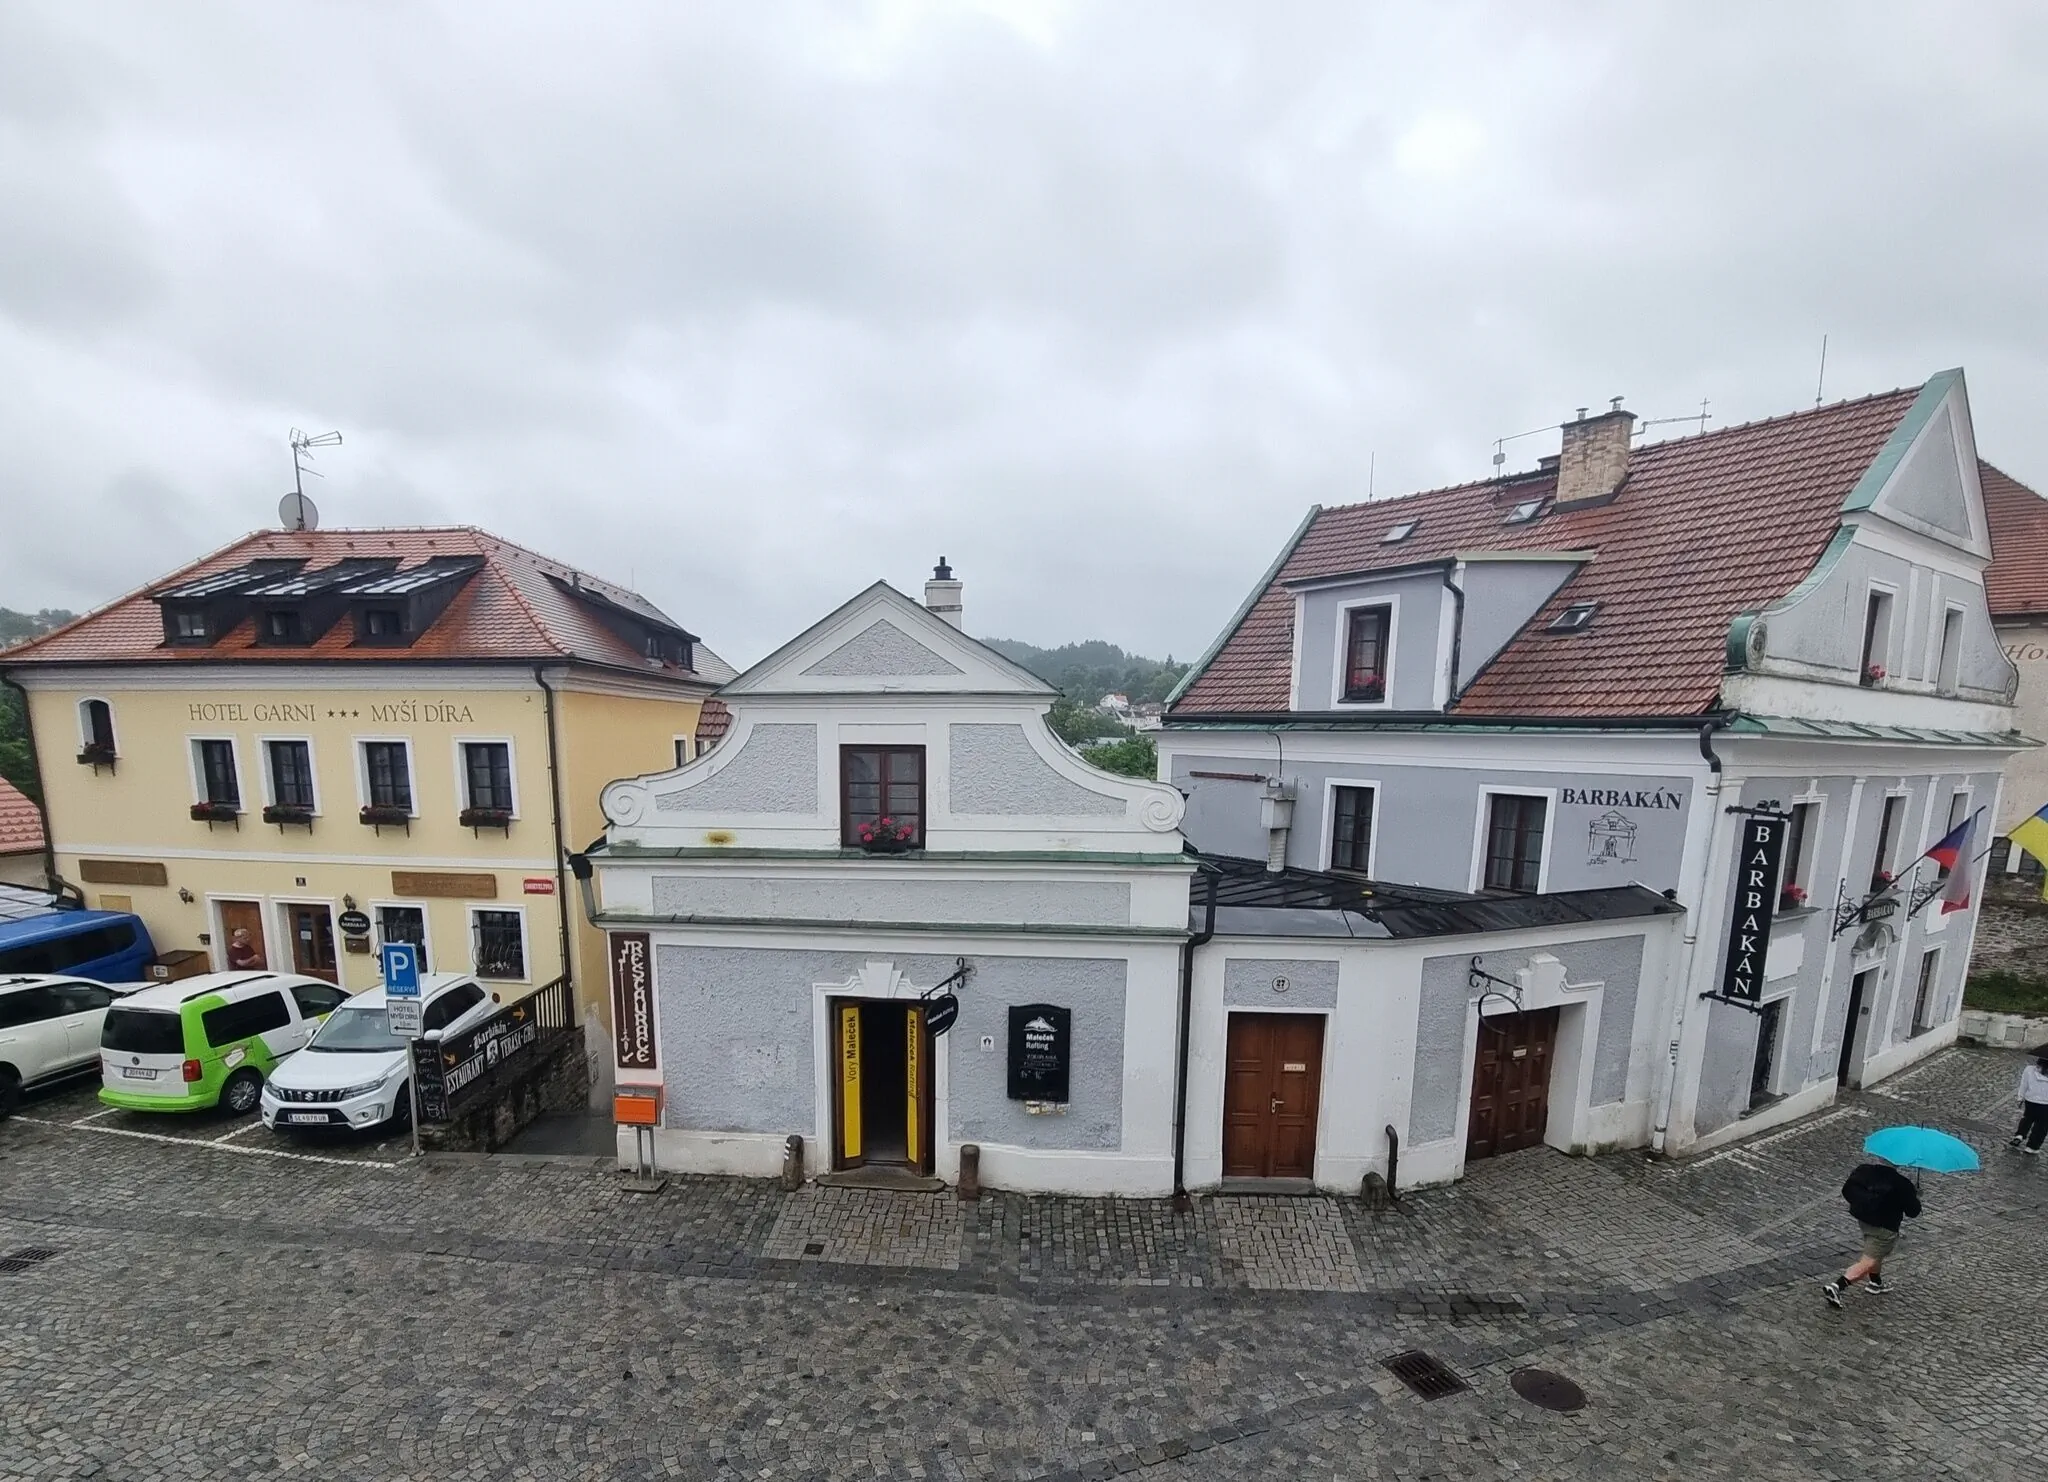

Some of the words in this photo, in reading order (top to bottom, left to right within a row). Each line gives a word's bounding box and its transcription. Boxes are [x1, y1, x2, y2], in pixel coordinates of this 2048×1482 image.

[2002, 642, 2048, 660] Ho
[188, 703, 249, 721] HOTEL
[253, 703, 316, 722] GARNI
[371, 699, 418, 722] MYŠÍ
[424, 699, 474, 722] DÍRA
[1561, 786, 1683, 811] BARBAKÁN
[1734, 825, 1771, 995] BARBAKÁN
[389, 951, 409, 981] P
[847, 1015, 857, 1060] Maleček
[1026, 1033, 1055, 1042] Maleček
[1026, 1042, 1049, 1051] Rafting
[445, 1053, 485, 1096] ESTAURANT
[847, 1061, 858, 1083] Vory
